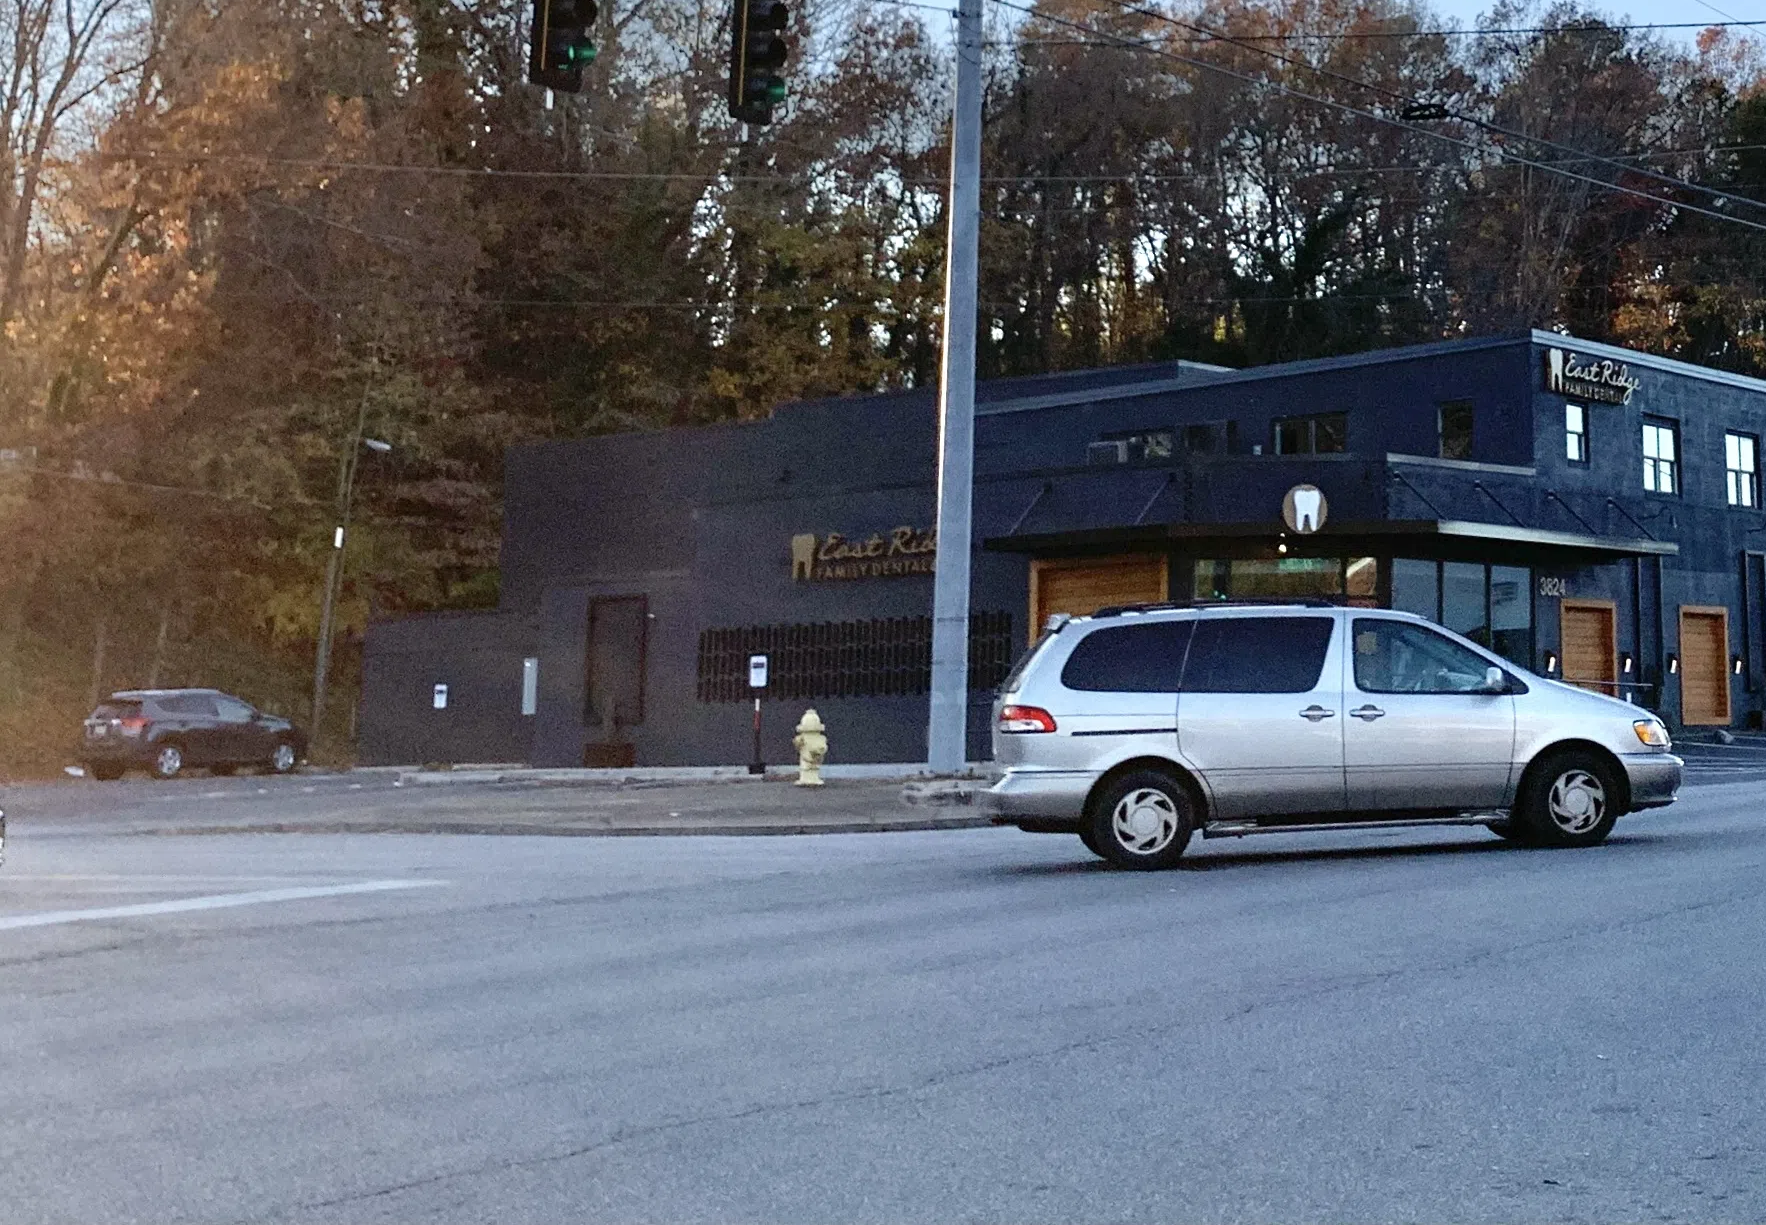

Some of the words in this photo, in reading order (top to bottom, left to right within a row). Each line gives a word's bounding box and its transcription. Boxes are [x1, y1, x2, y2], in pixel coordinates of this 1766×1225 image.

[1565, 353, 1600, 382] East
[1601, 360, 1642, 406] Ridge
[818, 532, 884, 560] East
[1540, 577, 1566, 596] 3824
